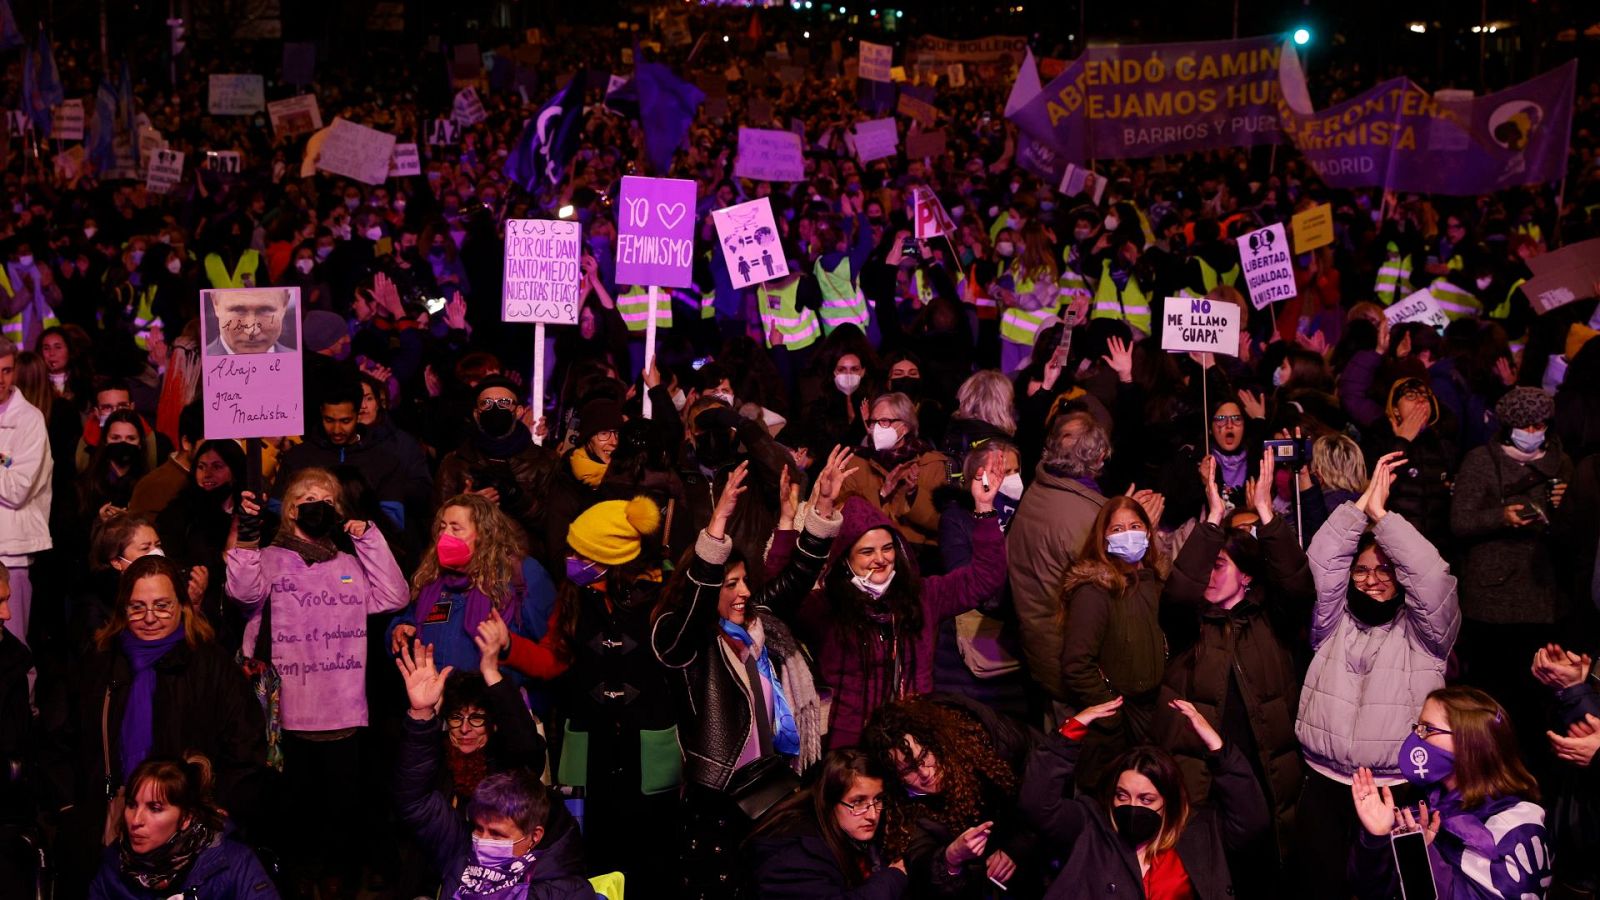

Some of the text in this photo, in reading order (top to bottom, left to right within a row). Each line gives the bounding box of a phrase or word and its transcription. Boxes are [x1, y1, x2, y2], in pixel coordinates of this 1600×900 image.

[1175, 47, 1281, 81] CAMIN
[1122, 123, 1208, 145] BARRIOS
[1214, 119, 1226, 135] Y
[625, 197, 649, 228] YO
[534, 235, 553, 258] QUÉ
[555, 239, 577, 259] DAN
[617, 234, 692, 268] FEMINISMO
[507, 258, 577, 282] TANTO MIEDO
[507, 281, 578, 303] NUESTRAS TETAS?
[1191, 299, 1211, 314] NO
[1167, 314, 1228, 327] ME LLAMO
[269, 359, 282, 372] el
[212, 391, 243, 411] gran
[305, 628, 319, 641] el
